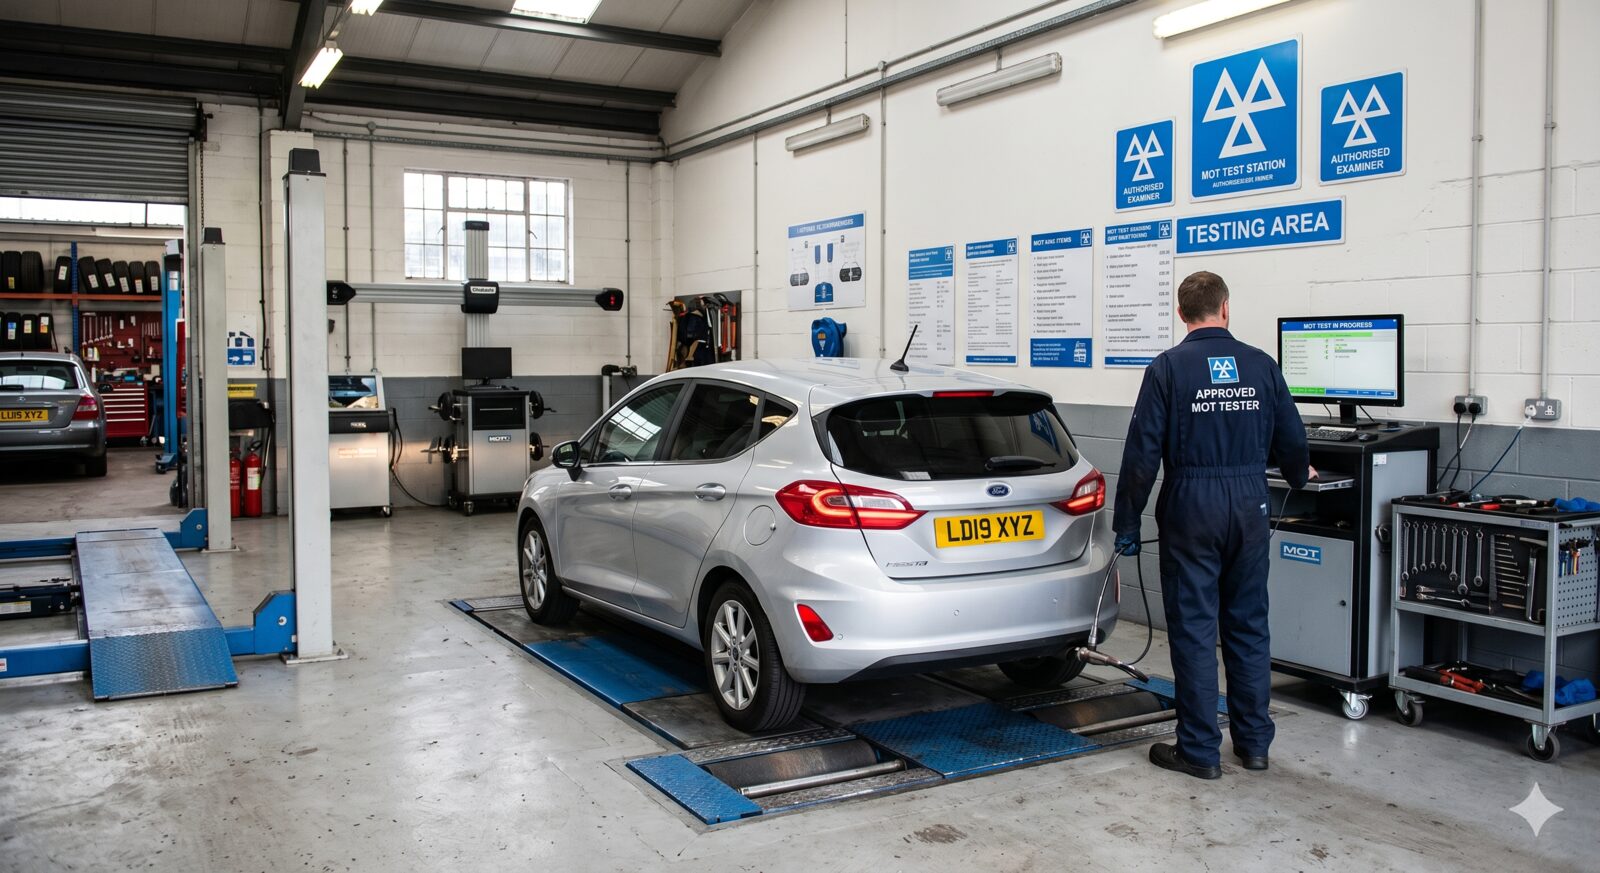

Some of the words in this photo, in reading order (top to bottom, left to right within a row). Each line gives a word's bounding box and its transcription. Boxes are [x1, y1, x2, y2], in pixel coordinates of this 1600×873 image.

[1331, 147, 1390, 164] AUTHORISED
[1202, 169, 1220, 179] MOT
[1223, 165, 1244, 176] TEST
[1246, 159, 1286, 173] STATION
[1336, 160, 1384, 175] EXAMINER
[1123, 182, 1164, 195] AUTHORISED
[1127, 193, 1160, 204] EXAMINER
[1186, 217, 1265, 244] TESTING
[1270, 211, 1330, 236] AREA
[1196, 387, 1256, 399] APPROVED
[1191, 402, 1216, 412] MOT
[1219, 400, 1260, 411] TESTER
[24, 411, 43, 419] XYZ
[947, 518, 990, 542] LD19
[997, 515, 1034, 538] XYZ
[1284, 545, 1319, 558] MOT
